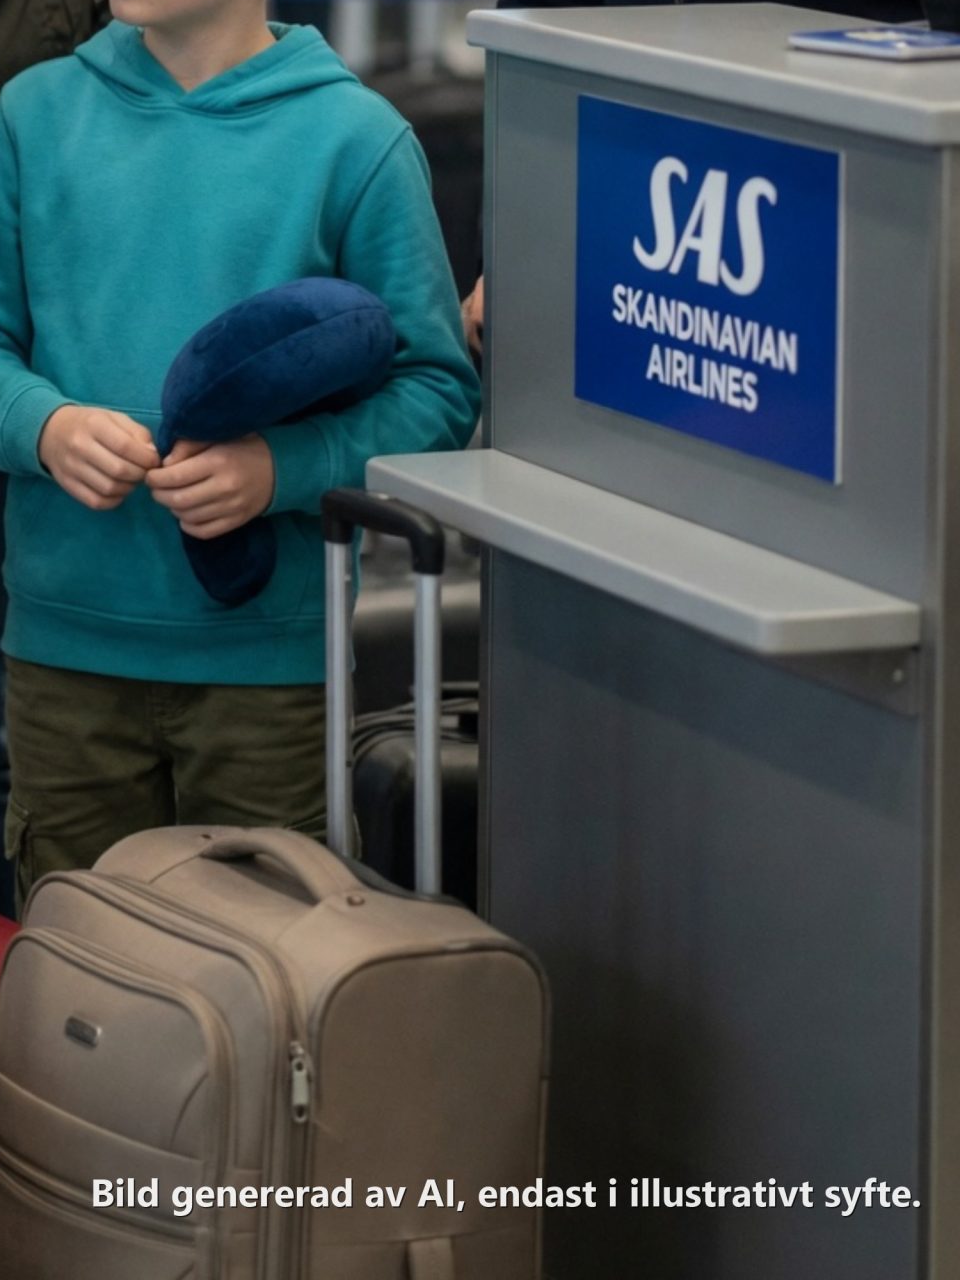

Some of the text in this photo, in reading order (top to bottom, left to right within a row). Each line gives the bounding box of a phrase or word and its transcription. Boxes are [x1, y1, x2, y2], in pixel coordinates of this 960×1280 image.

[632, 156, 778, 297] SAS
[611, 283, 798, 375] SKANDINAVIAN
[645, 343, 759, 413] AIRLINES
